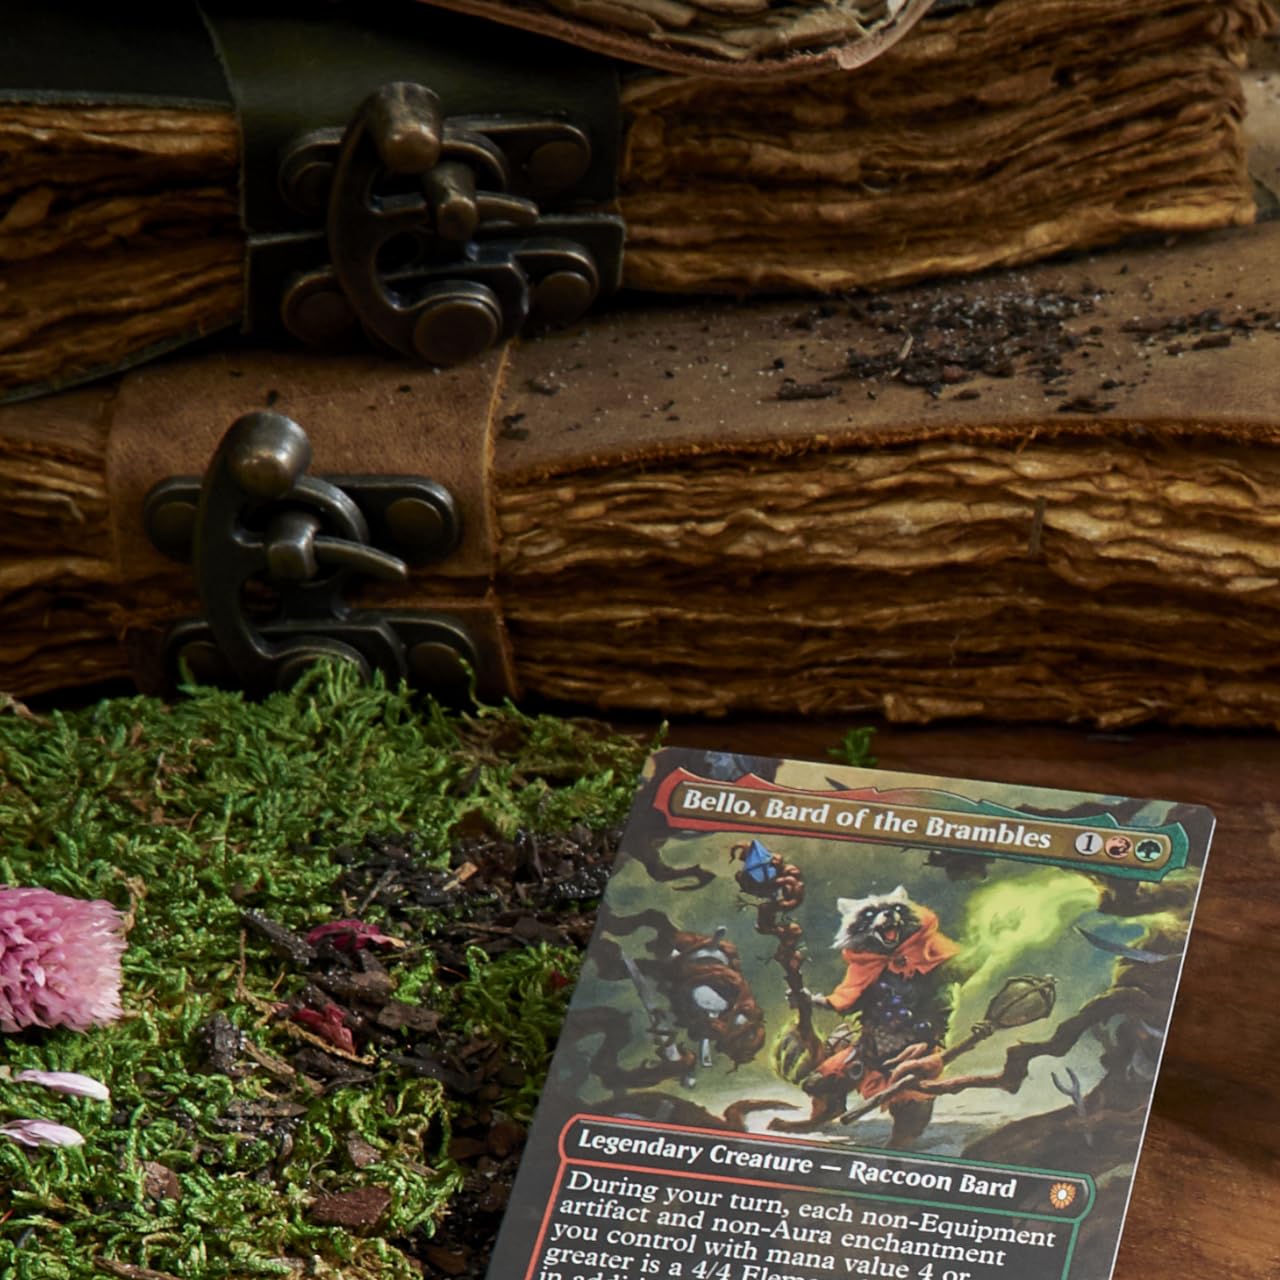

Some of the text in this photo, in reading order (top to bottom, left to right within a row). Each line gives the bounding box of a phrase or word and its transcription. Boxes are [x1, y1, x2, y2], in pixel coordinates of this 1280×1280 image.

[763, 797, 831, 825] Bard
[834, 807, 871, 830] of
[872, 809, 919, 834] the
[924, 815, 1052, 849] Brambles
[577, 1128, 1018, 1199] Legendary Creature Raccoon Bard
[558, 1197, 1007, 1267] artifact and non-Aura enchantment
[565, 1169, 1057, 1248] During your turn, each non-Equipment
[542, 1246, 635, 1271] greater
[639, 1251, 661, 1274] is
[667, 1261, 683, 1277] a
[549, 1222, 599, 1242] you
[605, 1229, 698, 1254] control
[703, 1237, 758, 1261] with
[764, 1247, 836, 1270] mana
[843, 1254, 910, 1280] value
